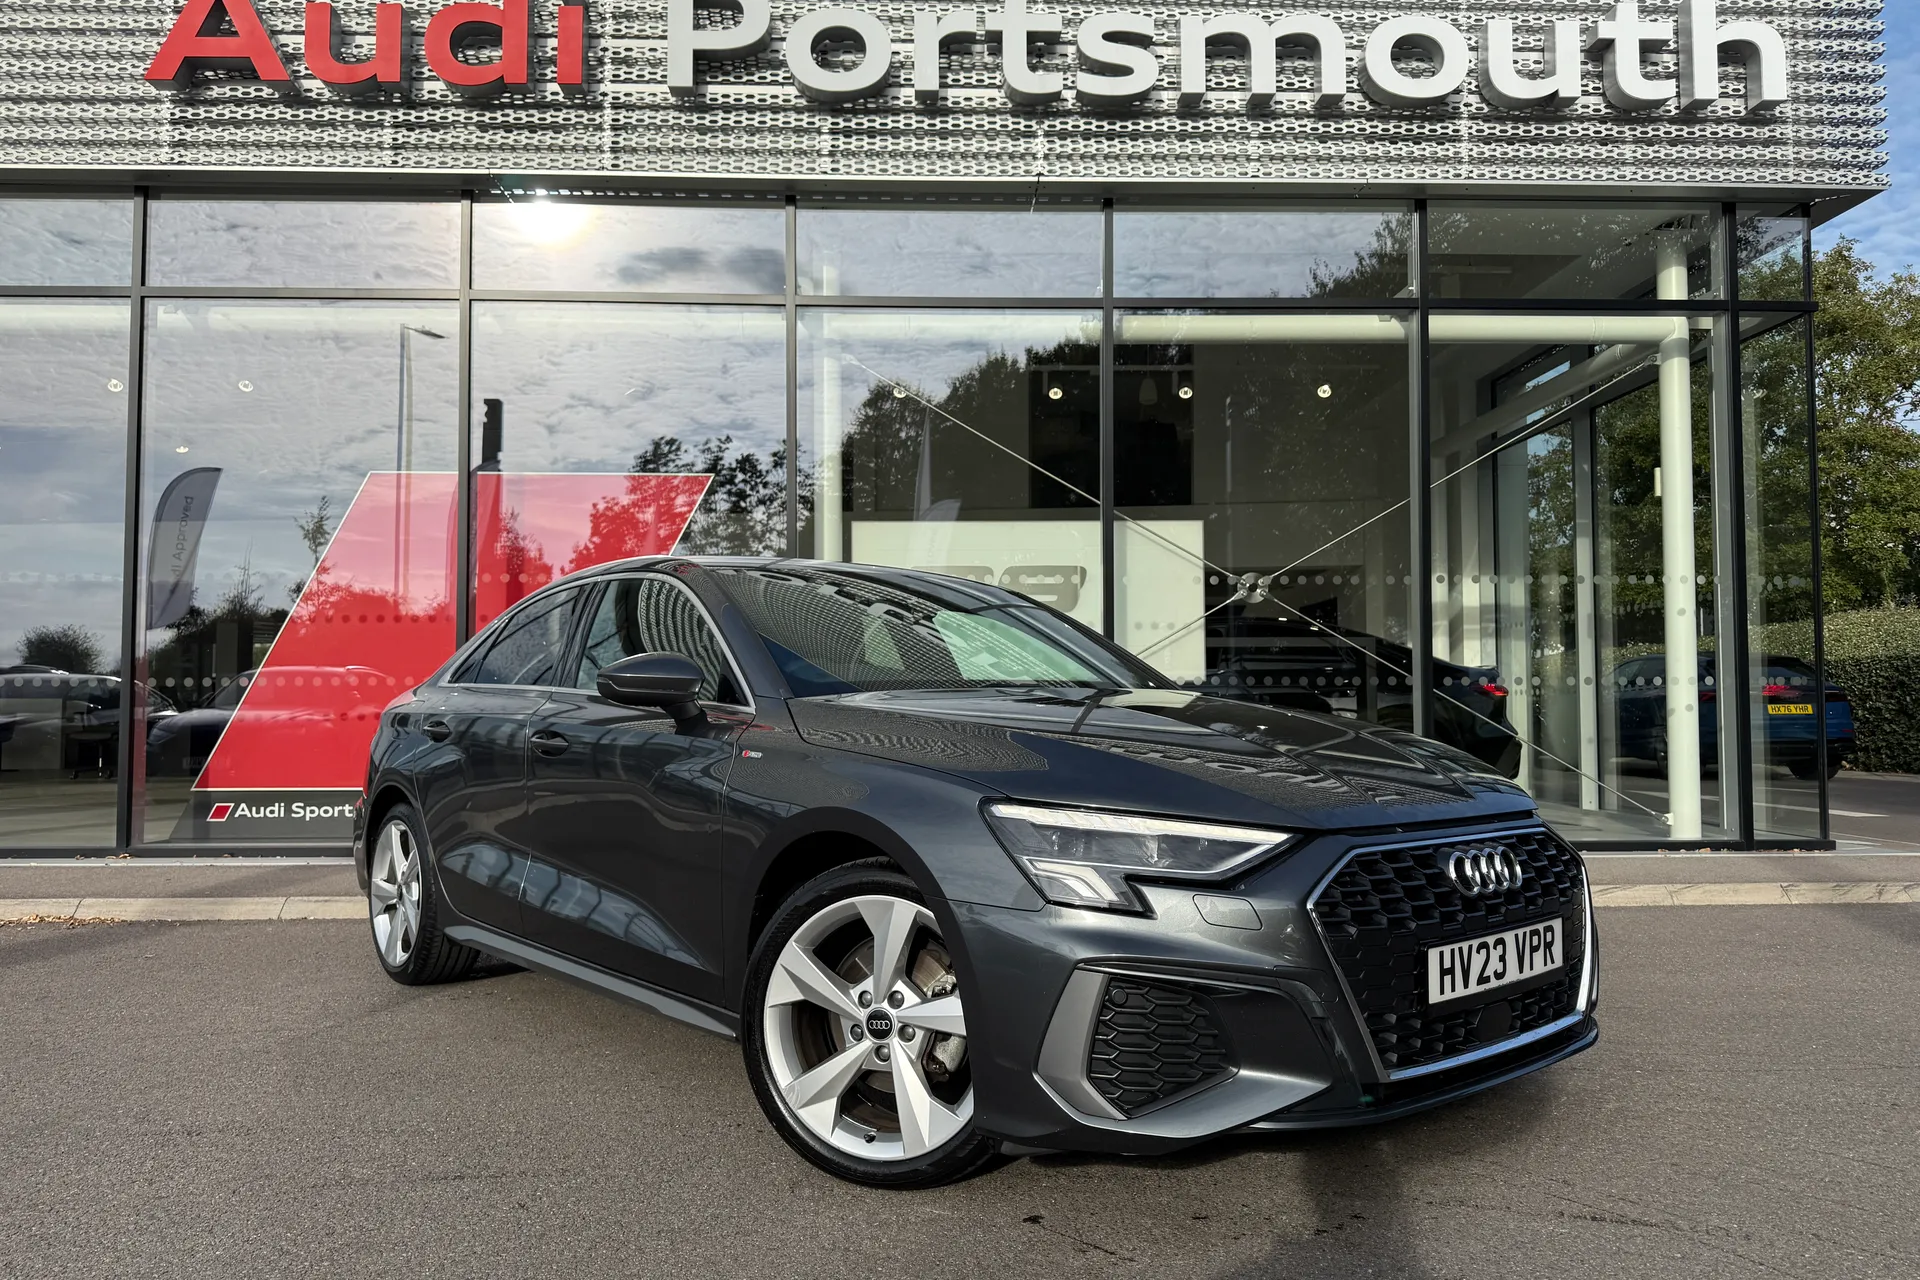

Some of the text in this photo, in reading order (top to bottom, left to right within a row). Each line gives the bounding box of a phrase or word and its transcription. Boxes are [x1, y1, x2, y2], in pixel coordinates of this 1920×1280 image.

[145, 0, 1787, 104] Audi Portsmouth
[172, 495, 194, 562] Approved
[1793, 705, 1810, 713] YHR
[234, 803, 354, 821] Audi Sport
[1439, 924, 1555, 996] HV23 VPR
